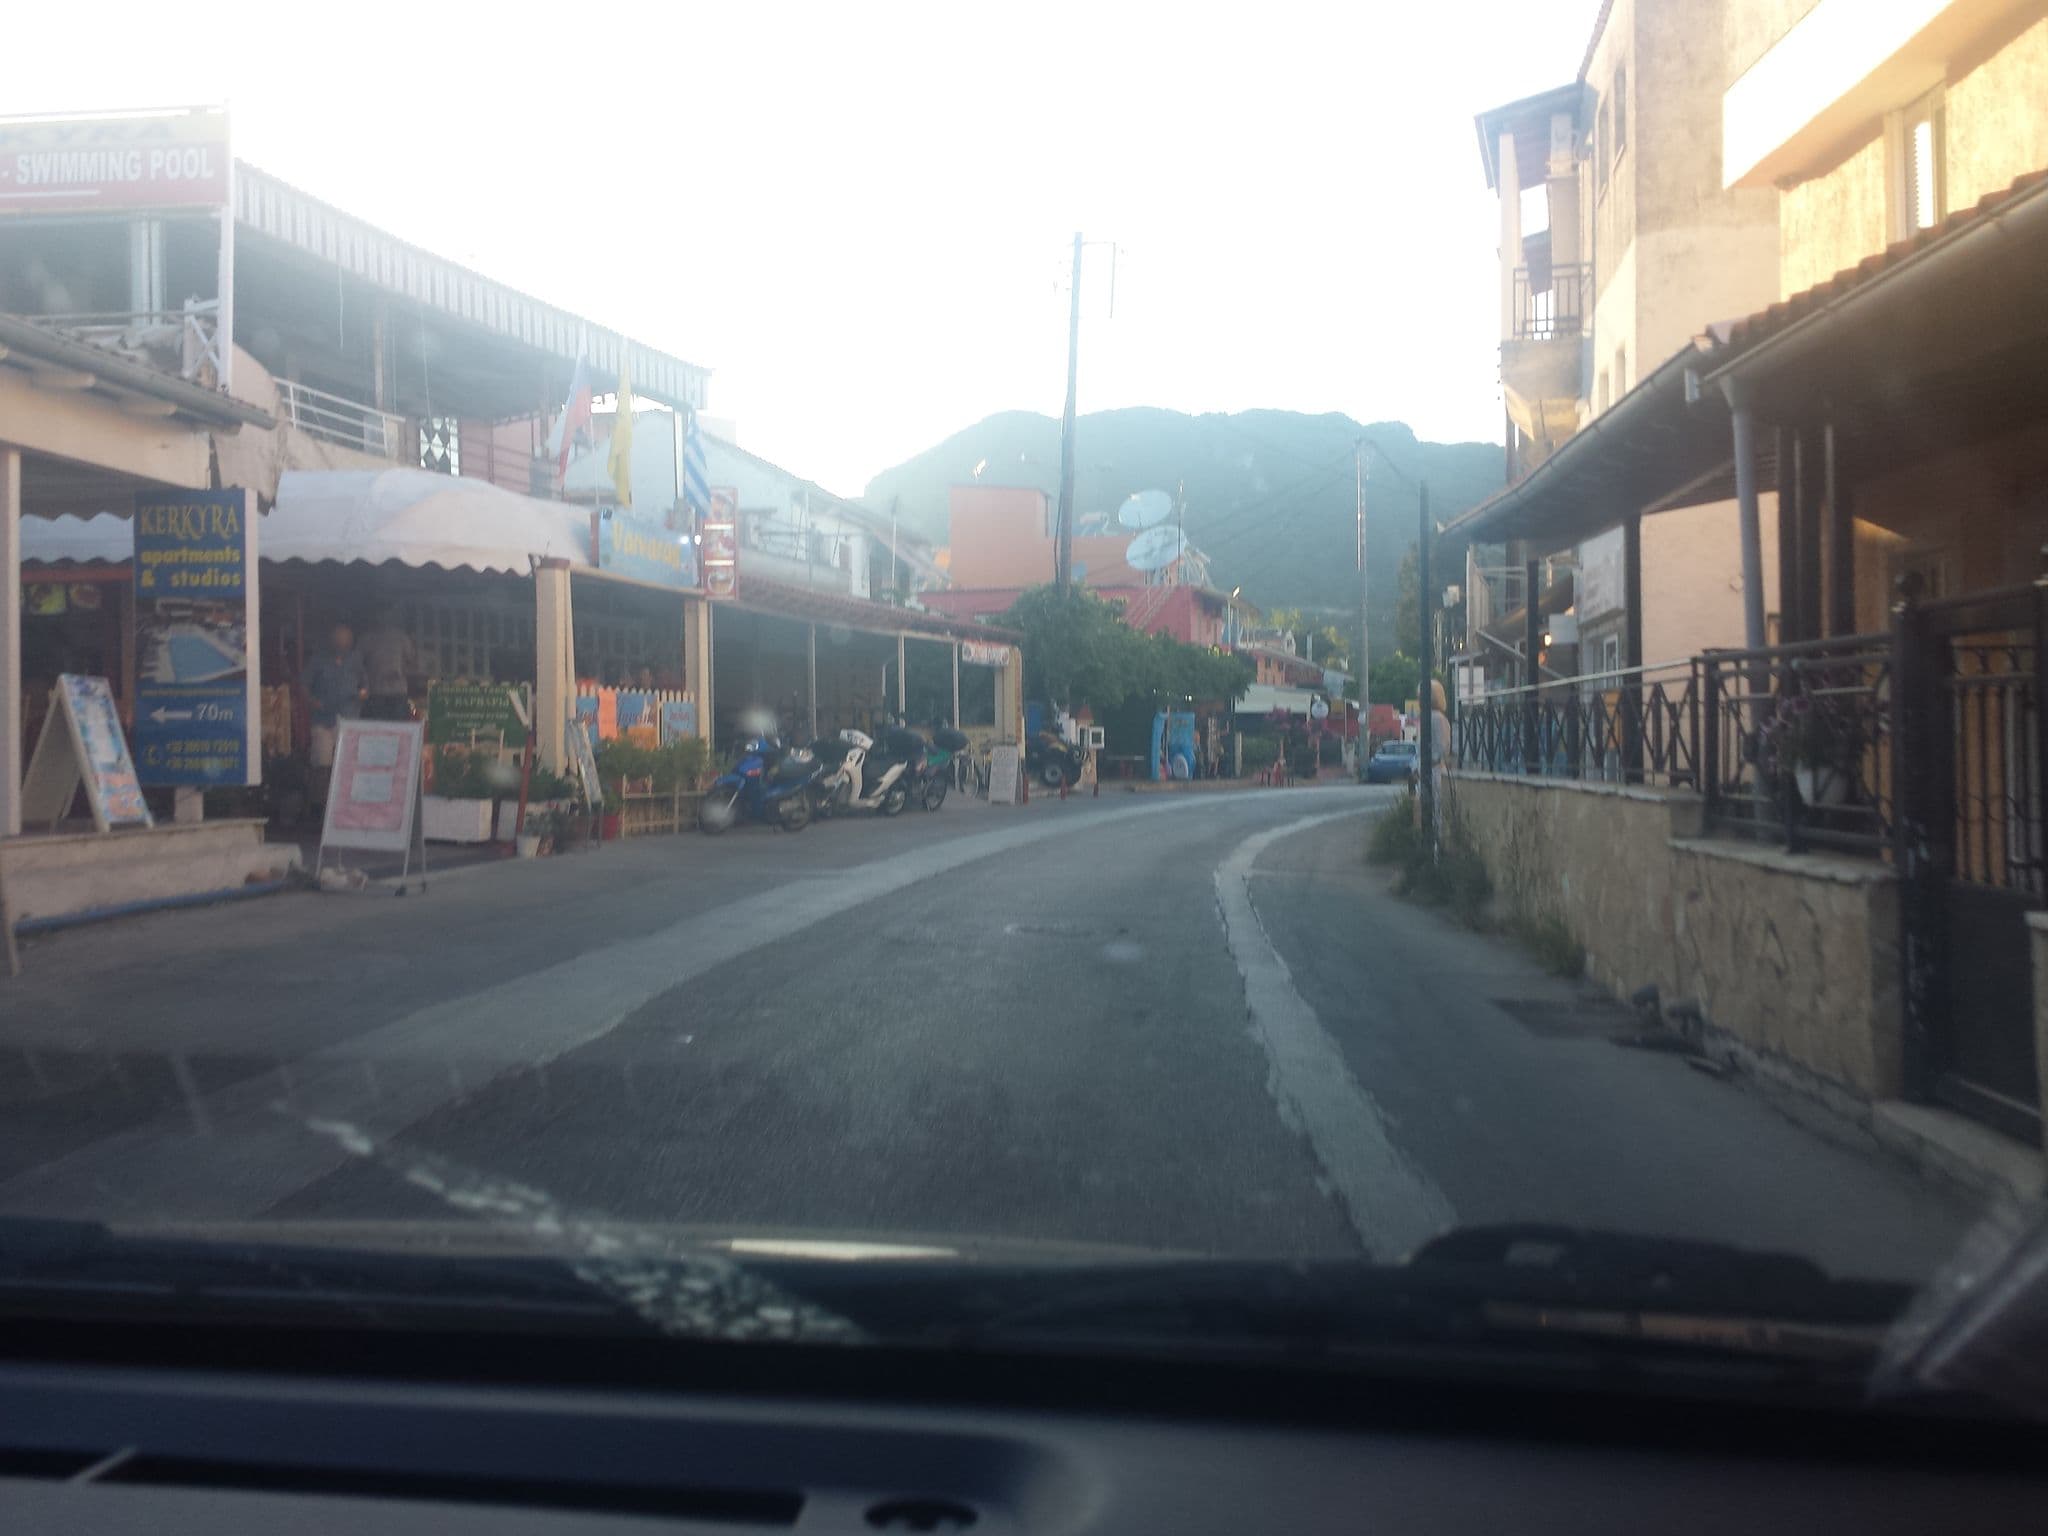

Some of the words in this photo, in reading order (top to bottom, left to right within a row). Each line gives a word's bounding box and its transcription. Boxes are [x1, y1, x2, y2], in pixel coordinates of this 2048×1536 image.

[16, 150, 143, 185] SWIMMING
[150, 147, 214, 180] POOL
[140, 504, 240, 540] KERKYRA
[140, 546, 241, 567] apartments
[141, 569, 155, 587] &
[171, 568, 241, 587] studios
[196, 703, 234, 721] 70m
